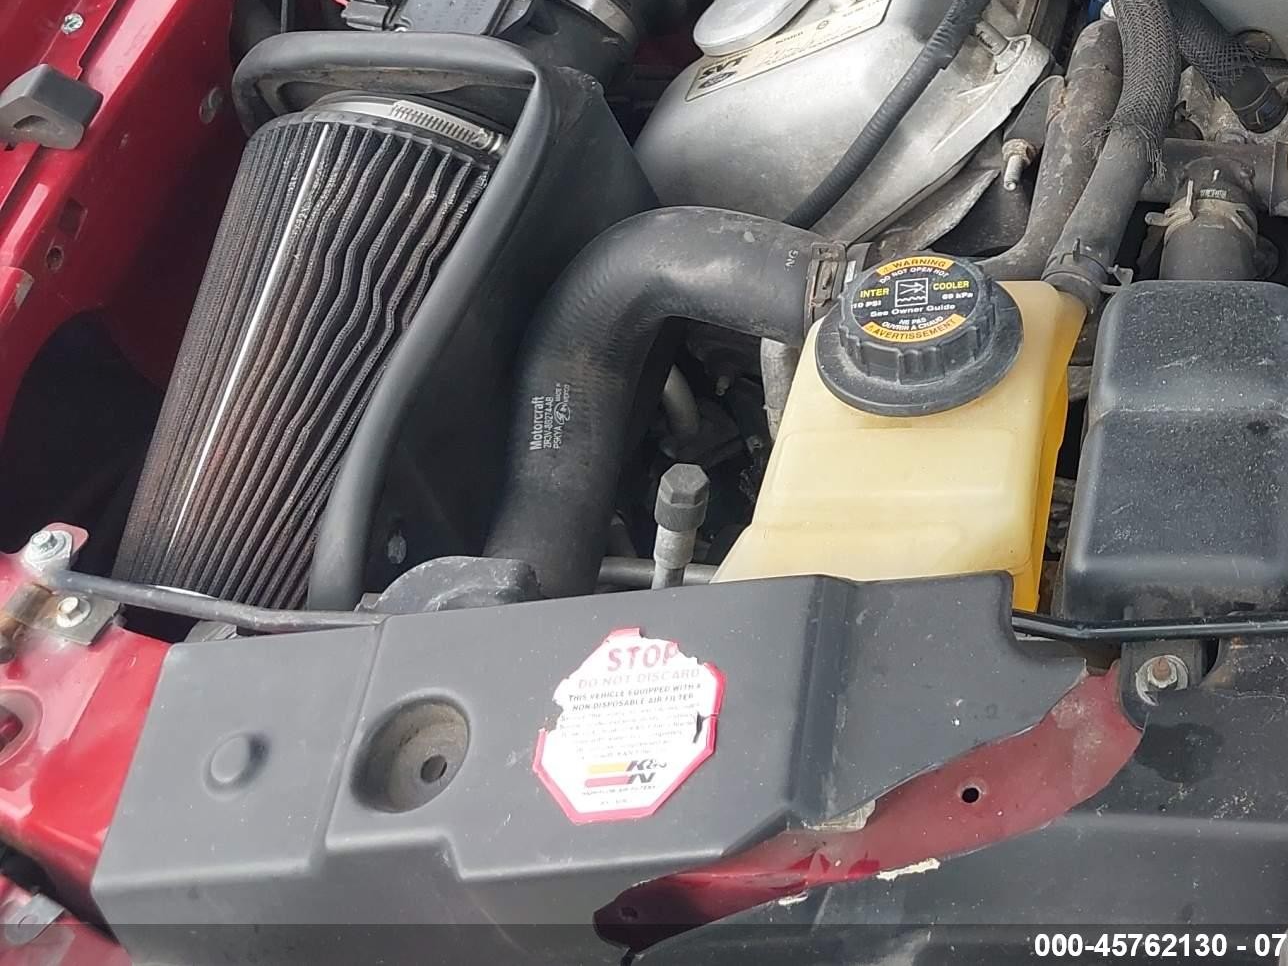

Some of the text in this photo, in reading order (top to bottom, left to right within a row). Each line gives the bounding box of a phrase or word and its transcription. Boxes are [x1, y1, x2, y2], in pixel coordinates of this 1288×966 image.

[891, 269, 908, 278] NOT
[909, 266, 932, 274] OPEN
[892, 258, 947, 269] WARNING
[860, 280, 970, 299] INTER COOLER
[870, 303, 956, 318] See Owner Guide
[874, 319, 957, 340] AVERTISSEMENT
[529, 396, 544, 450] Motorcraft
[607, 642, 680, 672] STOP
[578, 667, 700, 689] DO NOT DISCARD
[568, 694, 587, 703] THIS
[589, 690, 625, 701] VEHICLE
[627, 685, 671, 697] EQUIPPED
[671, 683, 694, 692] WITH
